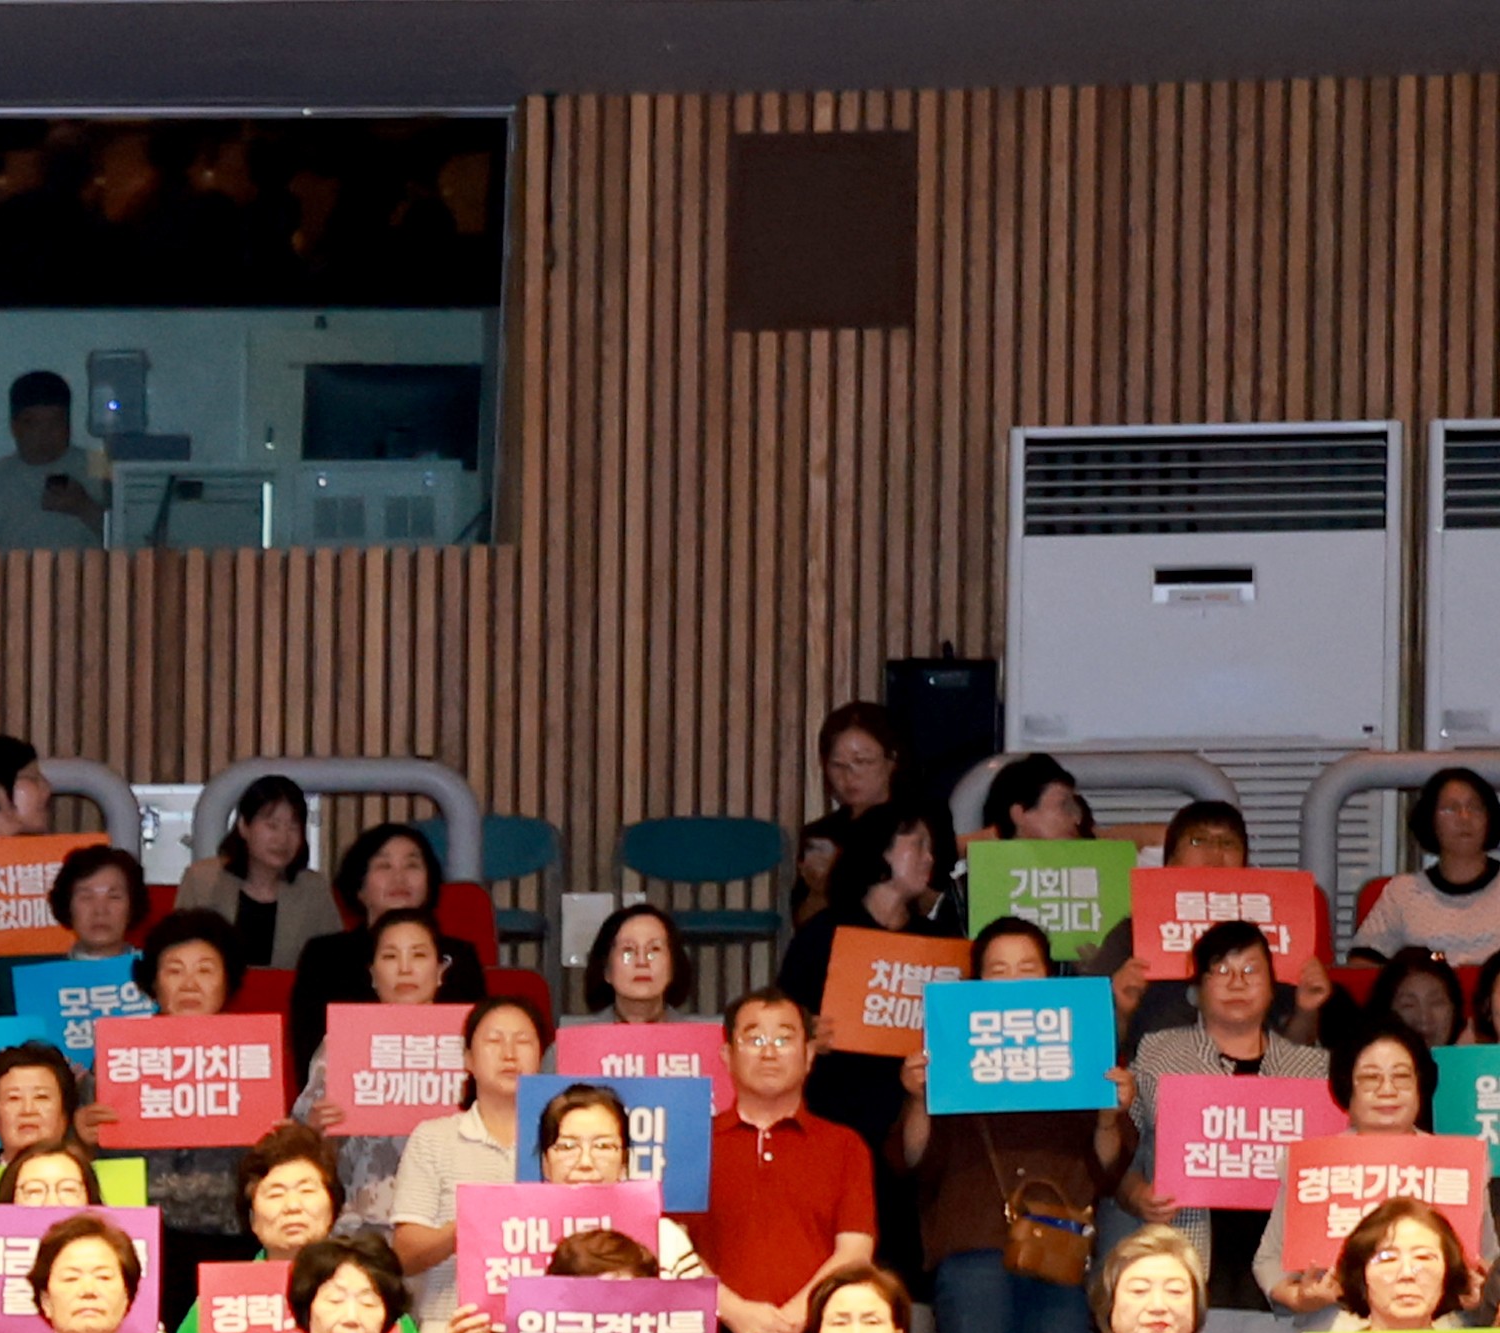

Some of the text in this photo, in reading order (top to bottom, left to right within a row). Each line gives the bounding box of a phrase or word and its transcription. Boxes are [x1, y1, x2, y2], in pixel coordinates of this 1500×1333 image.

[1011, 869, 1097, 897] 기회를
[1176, 893, 1271, 922] 돌봄을
[970, 1009, 1070, 1045] 모두의
[108, 1045, 270, 1081] 경력가치를
[372, 1036, 463, 1068] 돌봄을
[971, 1045, 1072, 1082] 성평등
[141, 1082, 240, 1117] 높이다
[1203, 1106, 1303, 1142] 하나된
[1299, 1165, 1468, 1202] 경력가치를
